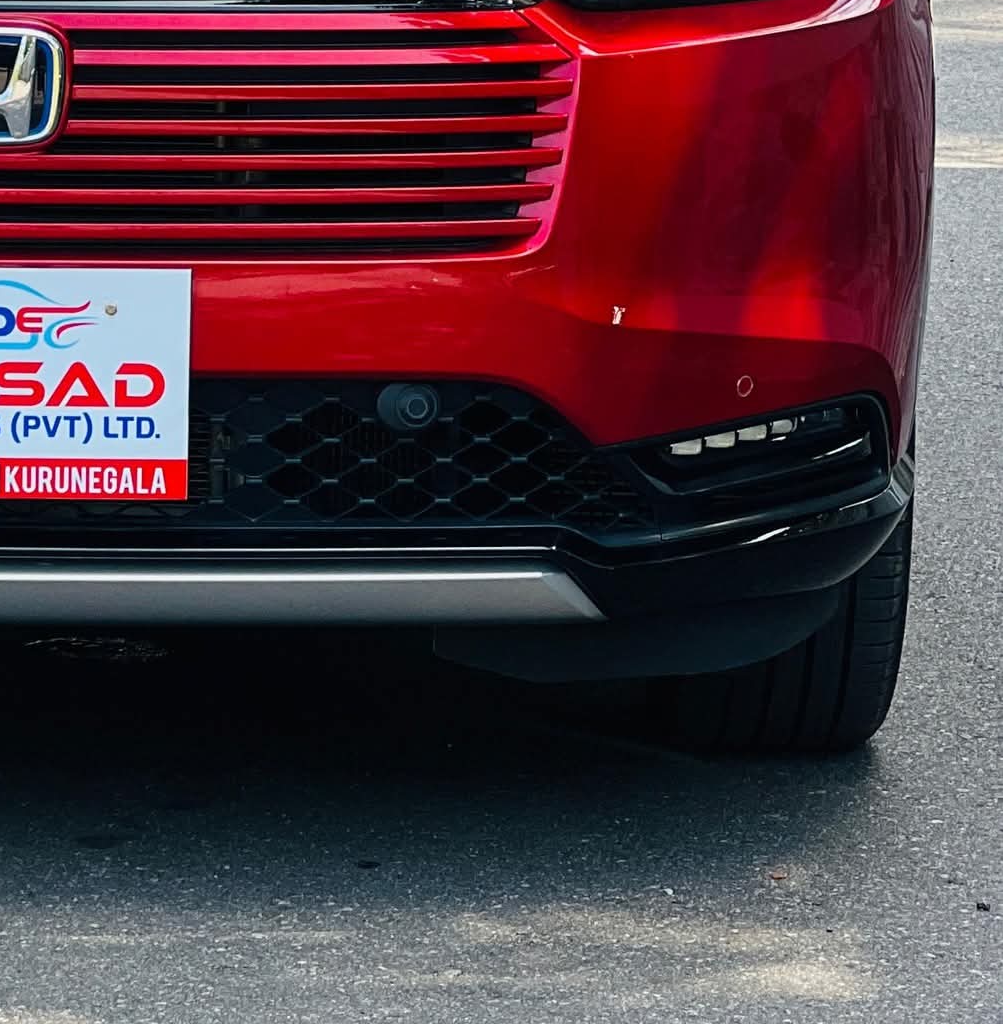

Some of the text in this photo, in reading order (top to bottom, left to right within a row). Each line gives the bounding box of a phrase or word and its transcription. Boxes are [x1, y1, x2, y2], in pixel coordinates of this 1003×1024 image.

[11, 411, 93, 444] (PVT)
[103, 416, 161, 439] LTD.
[4, 465, 166, 495] KURUNEGALA
